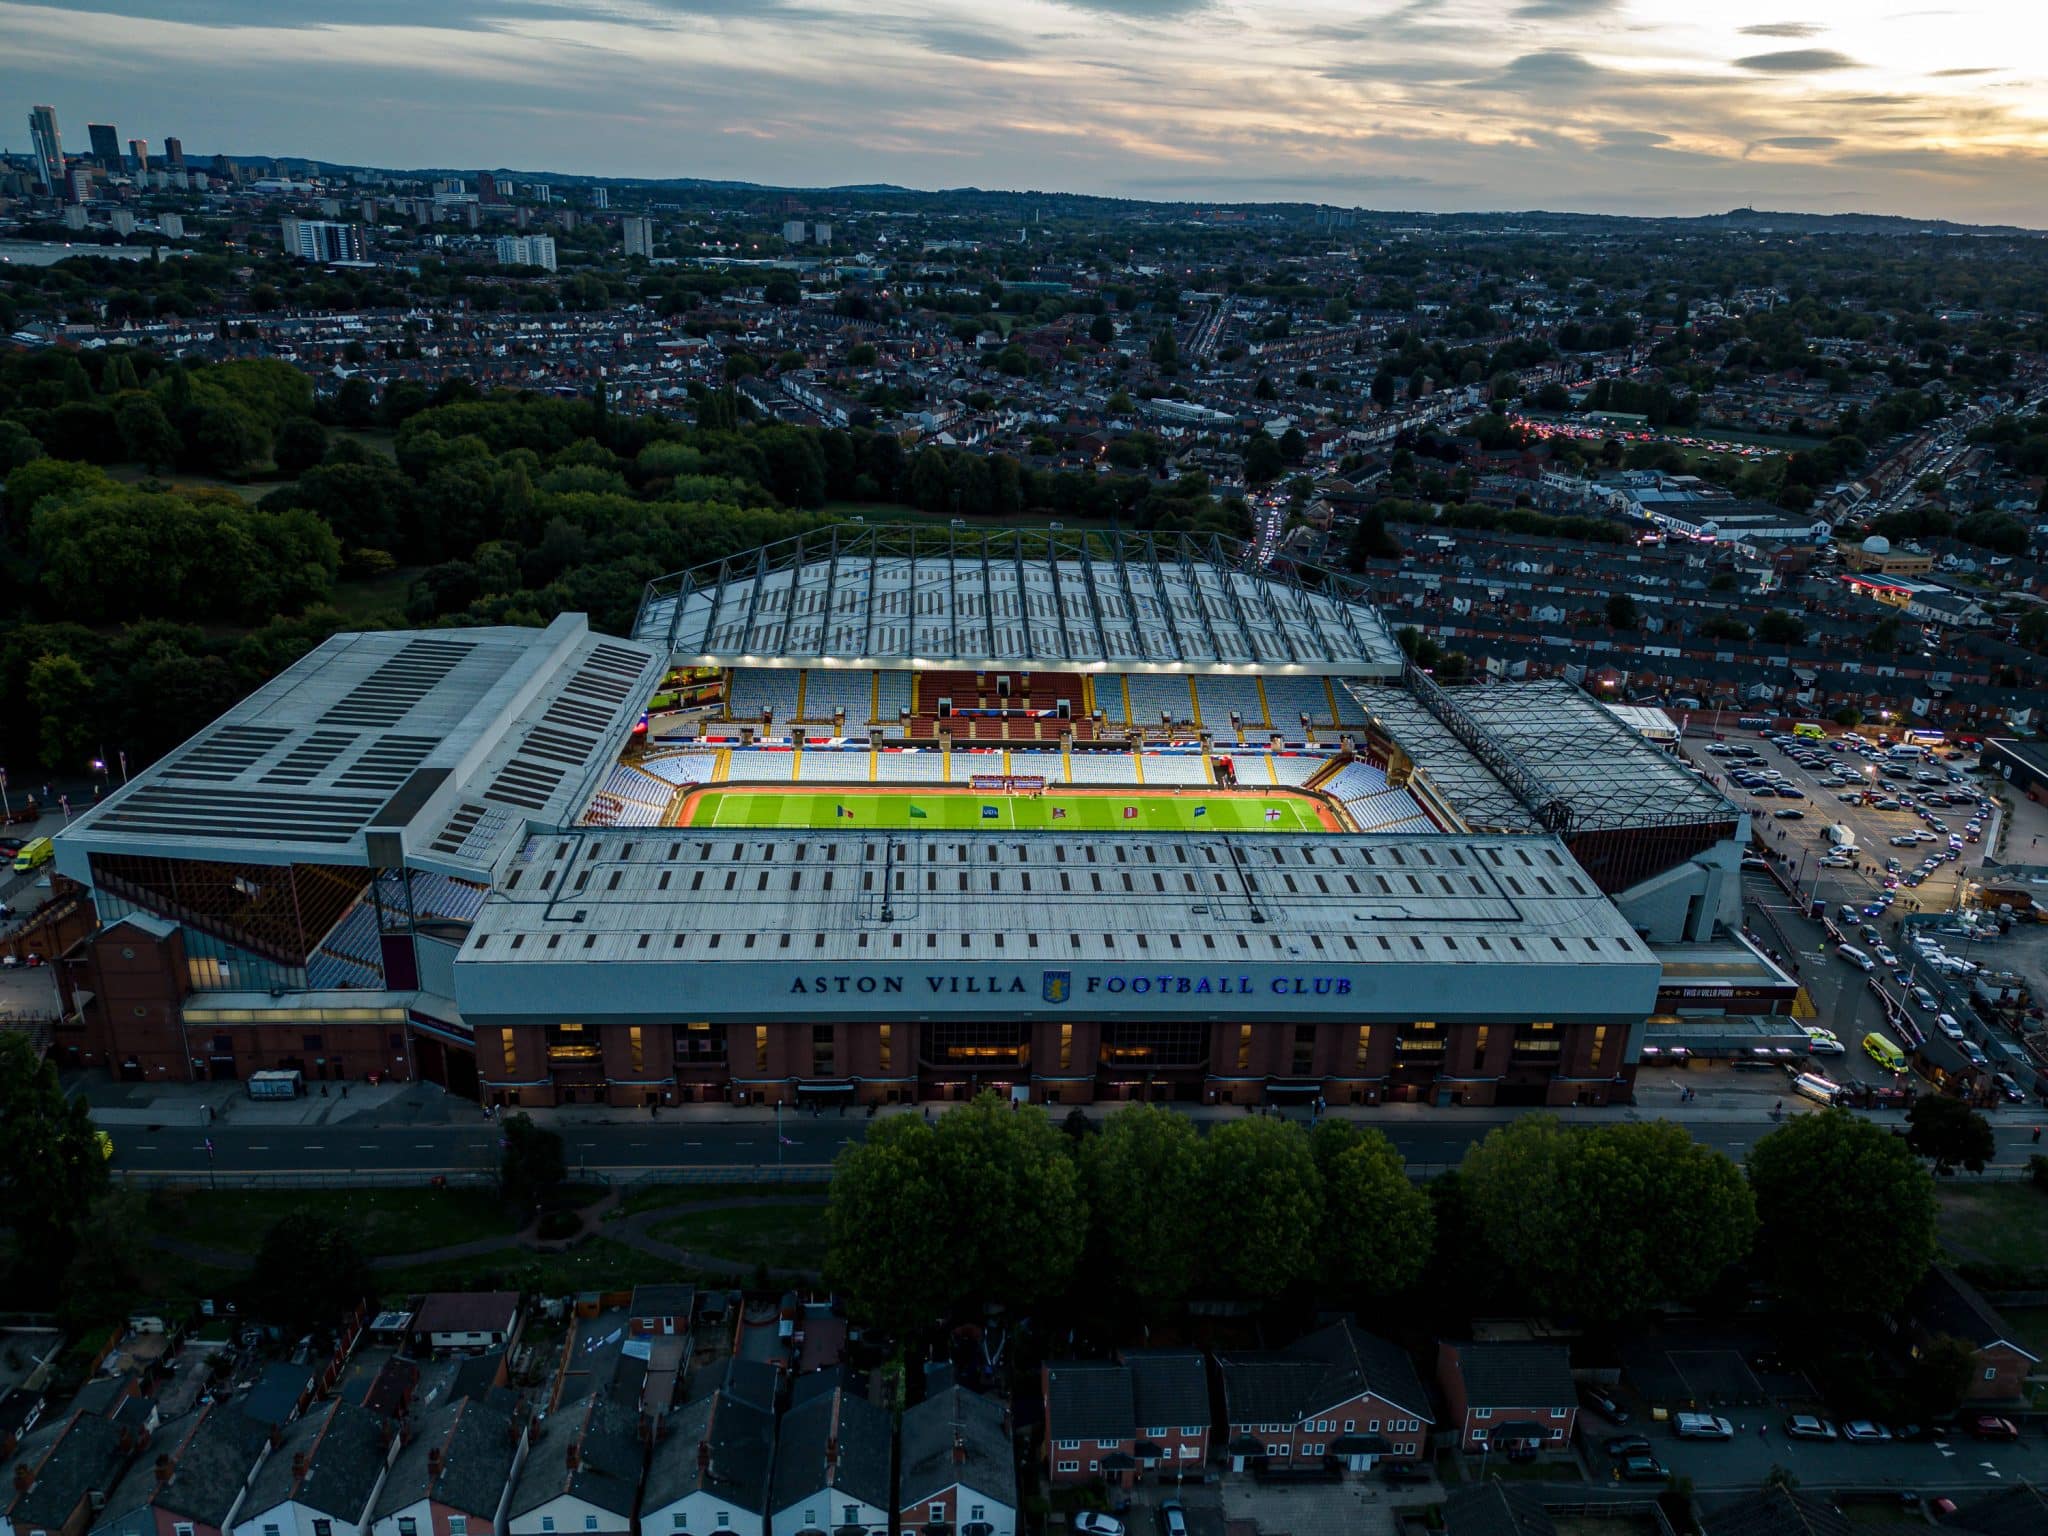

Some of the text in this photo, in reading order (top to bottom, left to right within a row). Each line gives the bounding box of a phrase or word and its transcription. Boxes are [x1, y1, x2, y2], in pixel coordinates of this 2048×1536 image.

[790, 976, 1351, 994] ASTON VILLA FOOTBALL CLUB
